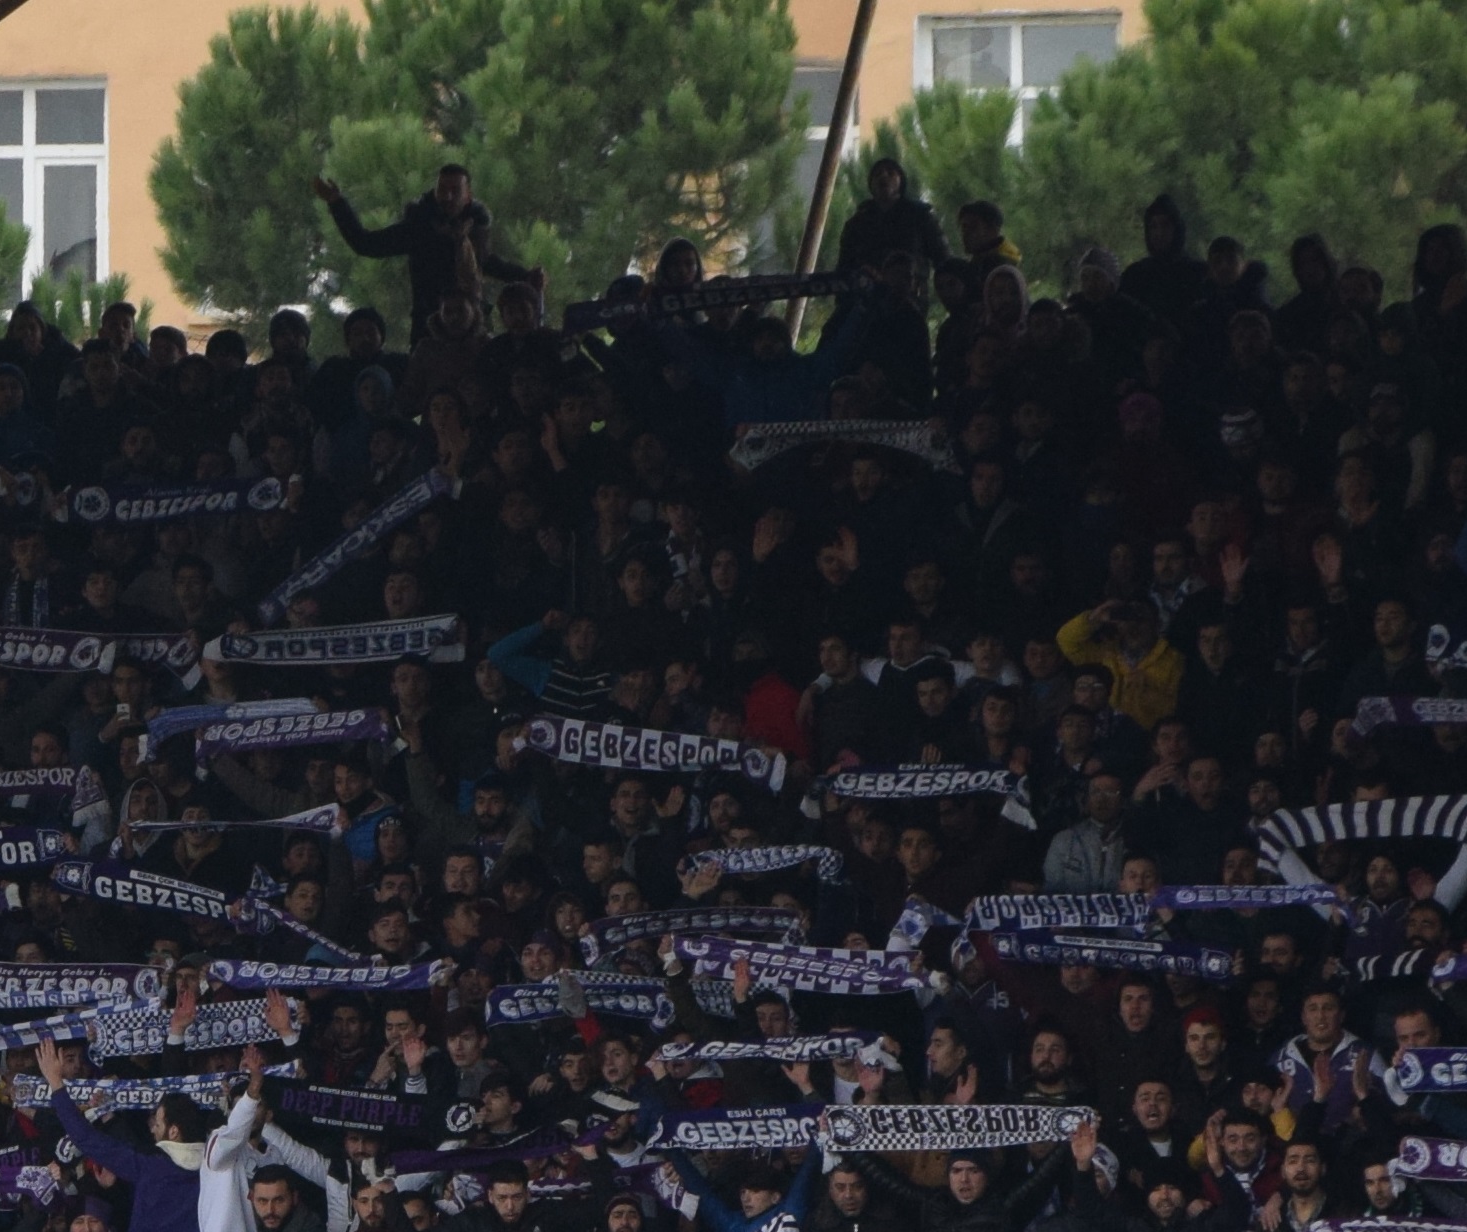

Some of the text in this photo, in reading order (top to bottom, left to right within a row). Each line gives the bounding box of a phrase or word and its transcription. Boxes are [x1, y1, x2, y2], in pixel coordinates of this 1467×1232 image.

[115, 491, 237, 521] GEBZESPOR
[204, 709, 367, 742] GEBZESPOR
[838, 770, 1007, 794] GEBZESPOR
[94, 875, 227, 919] GEBZESP
[282, 1089, 423, 1127] DEEP PURPLE
[676, 1119, 814, 1144] GEBZESPO
